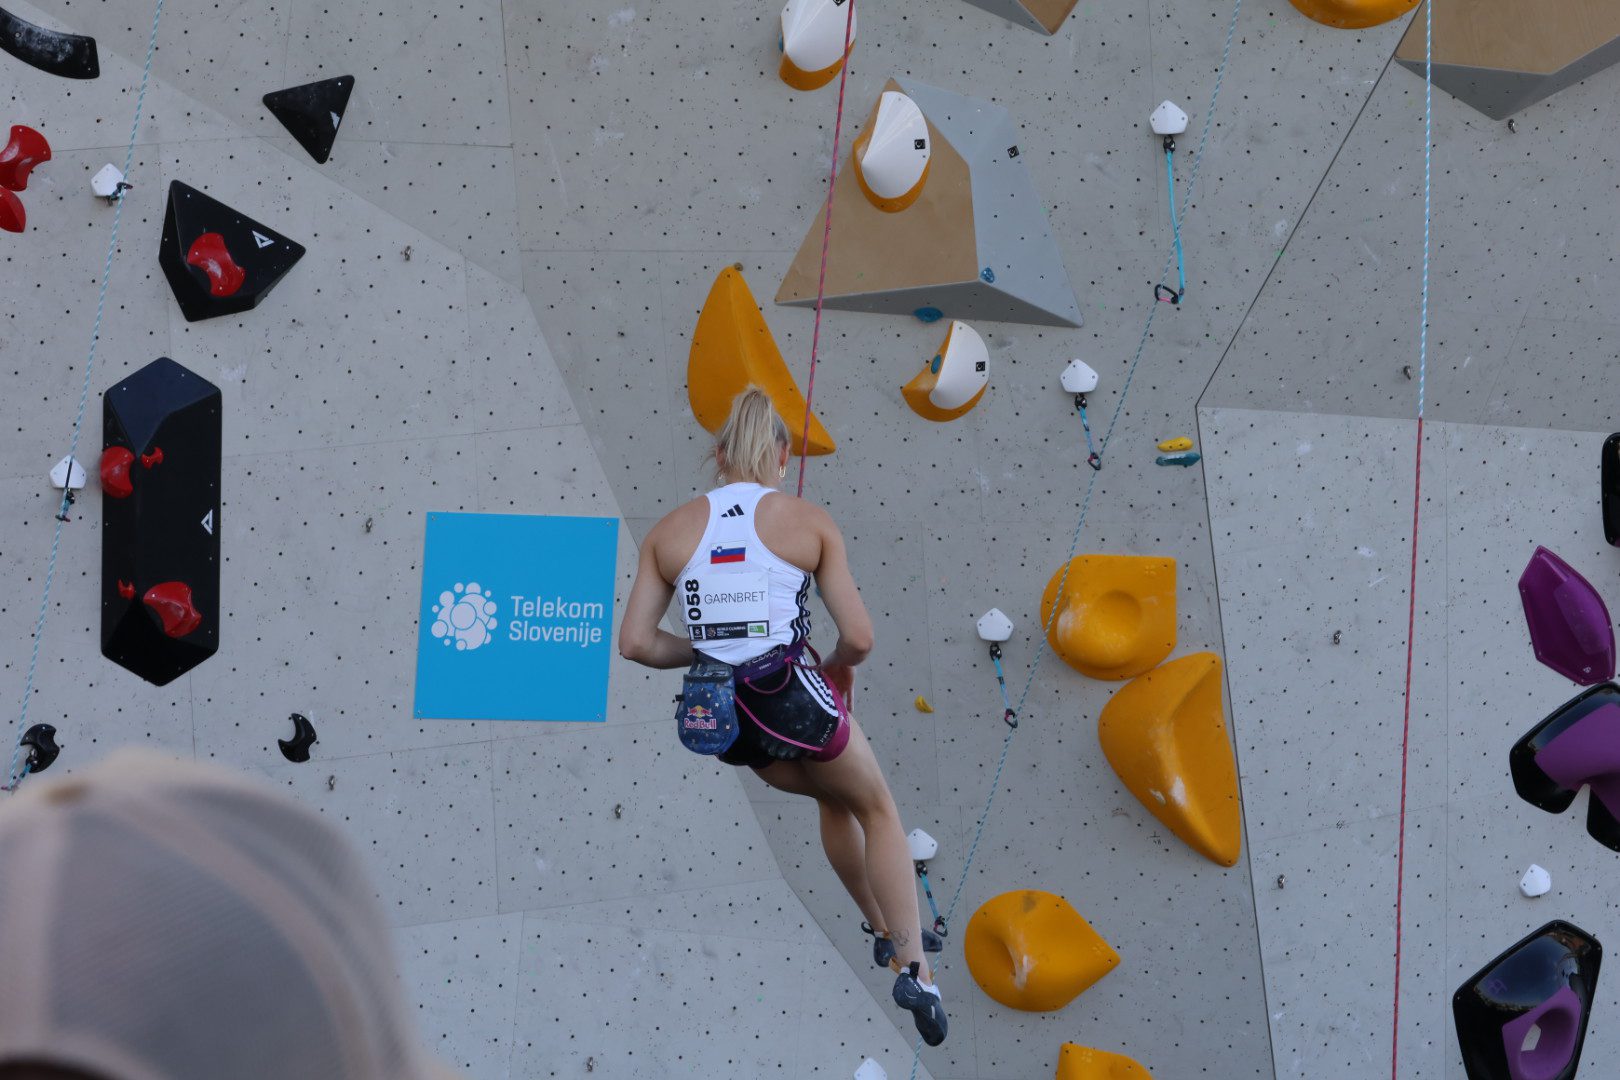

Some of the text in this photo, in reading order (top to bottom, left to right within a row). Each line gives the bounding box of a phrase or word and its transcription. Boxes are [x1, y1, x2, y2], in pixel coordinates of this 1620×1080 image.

[511, 596, 603, 619] Telekom
[685, 579, 702, 621] 058
[704, 591, 766, 604] GARNBRET
[509, 620, 602, 648] Slovenije
